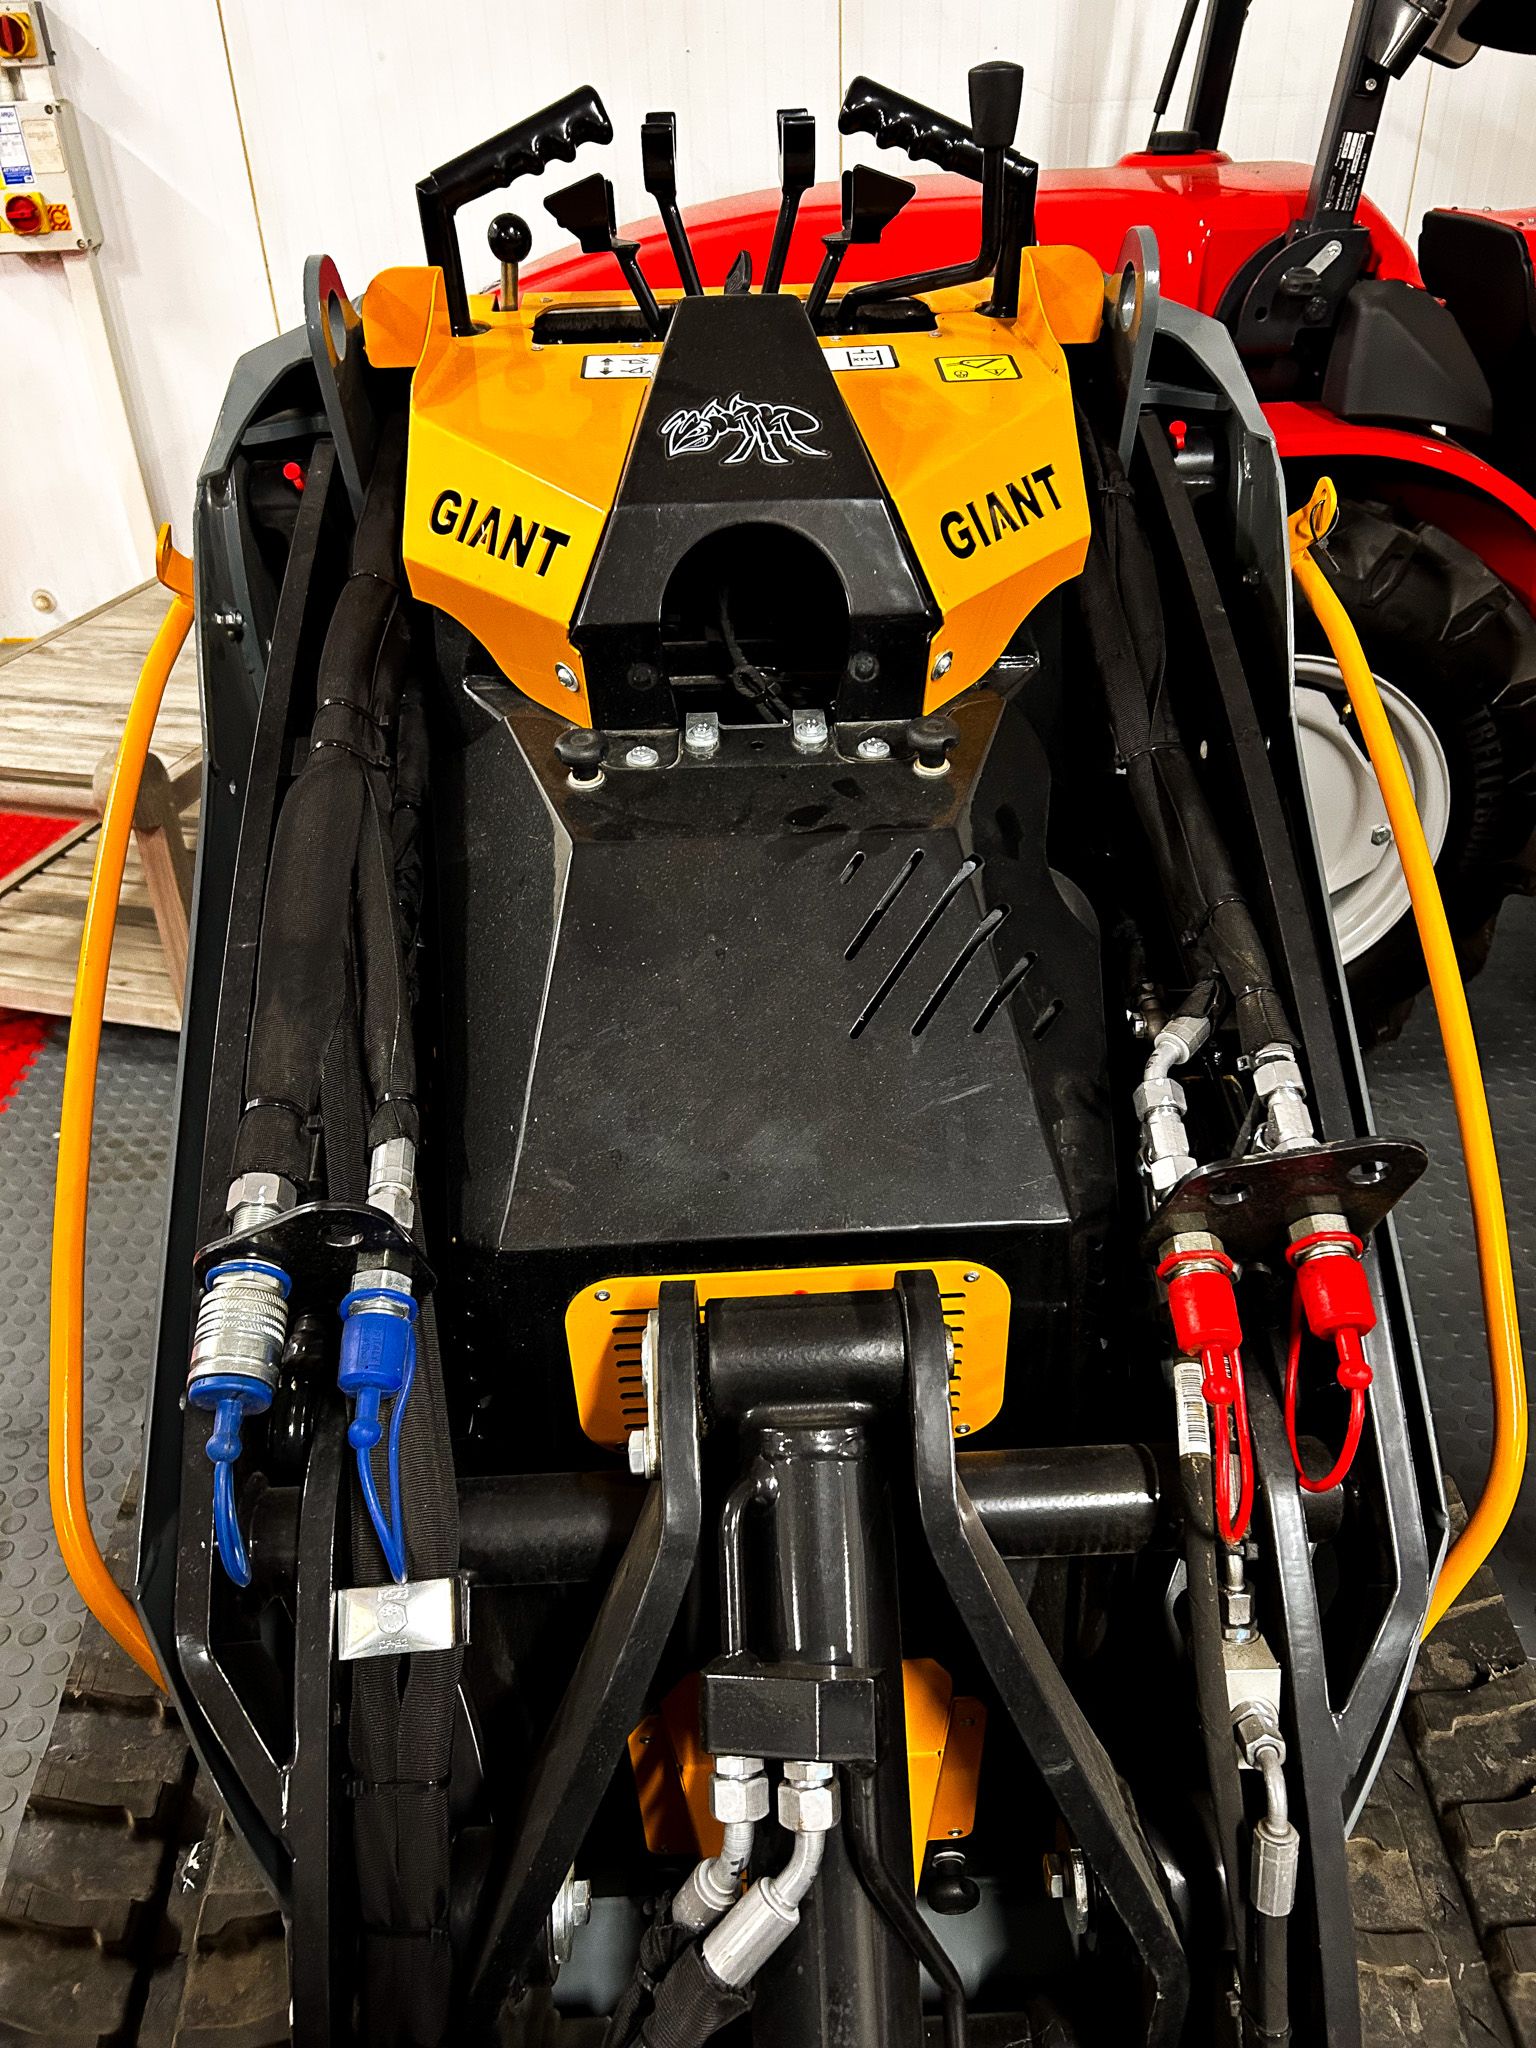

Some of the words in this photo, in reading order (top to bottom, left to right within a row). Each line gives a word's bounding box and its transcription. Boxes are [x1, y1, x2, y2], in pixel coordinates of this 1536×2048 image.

[430, 489, 571, 577] GIANT
[940, 463, 1062, 560] GIANT
[1459, 703, 1504, 872] TRELLEBO
